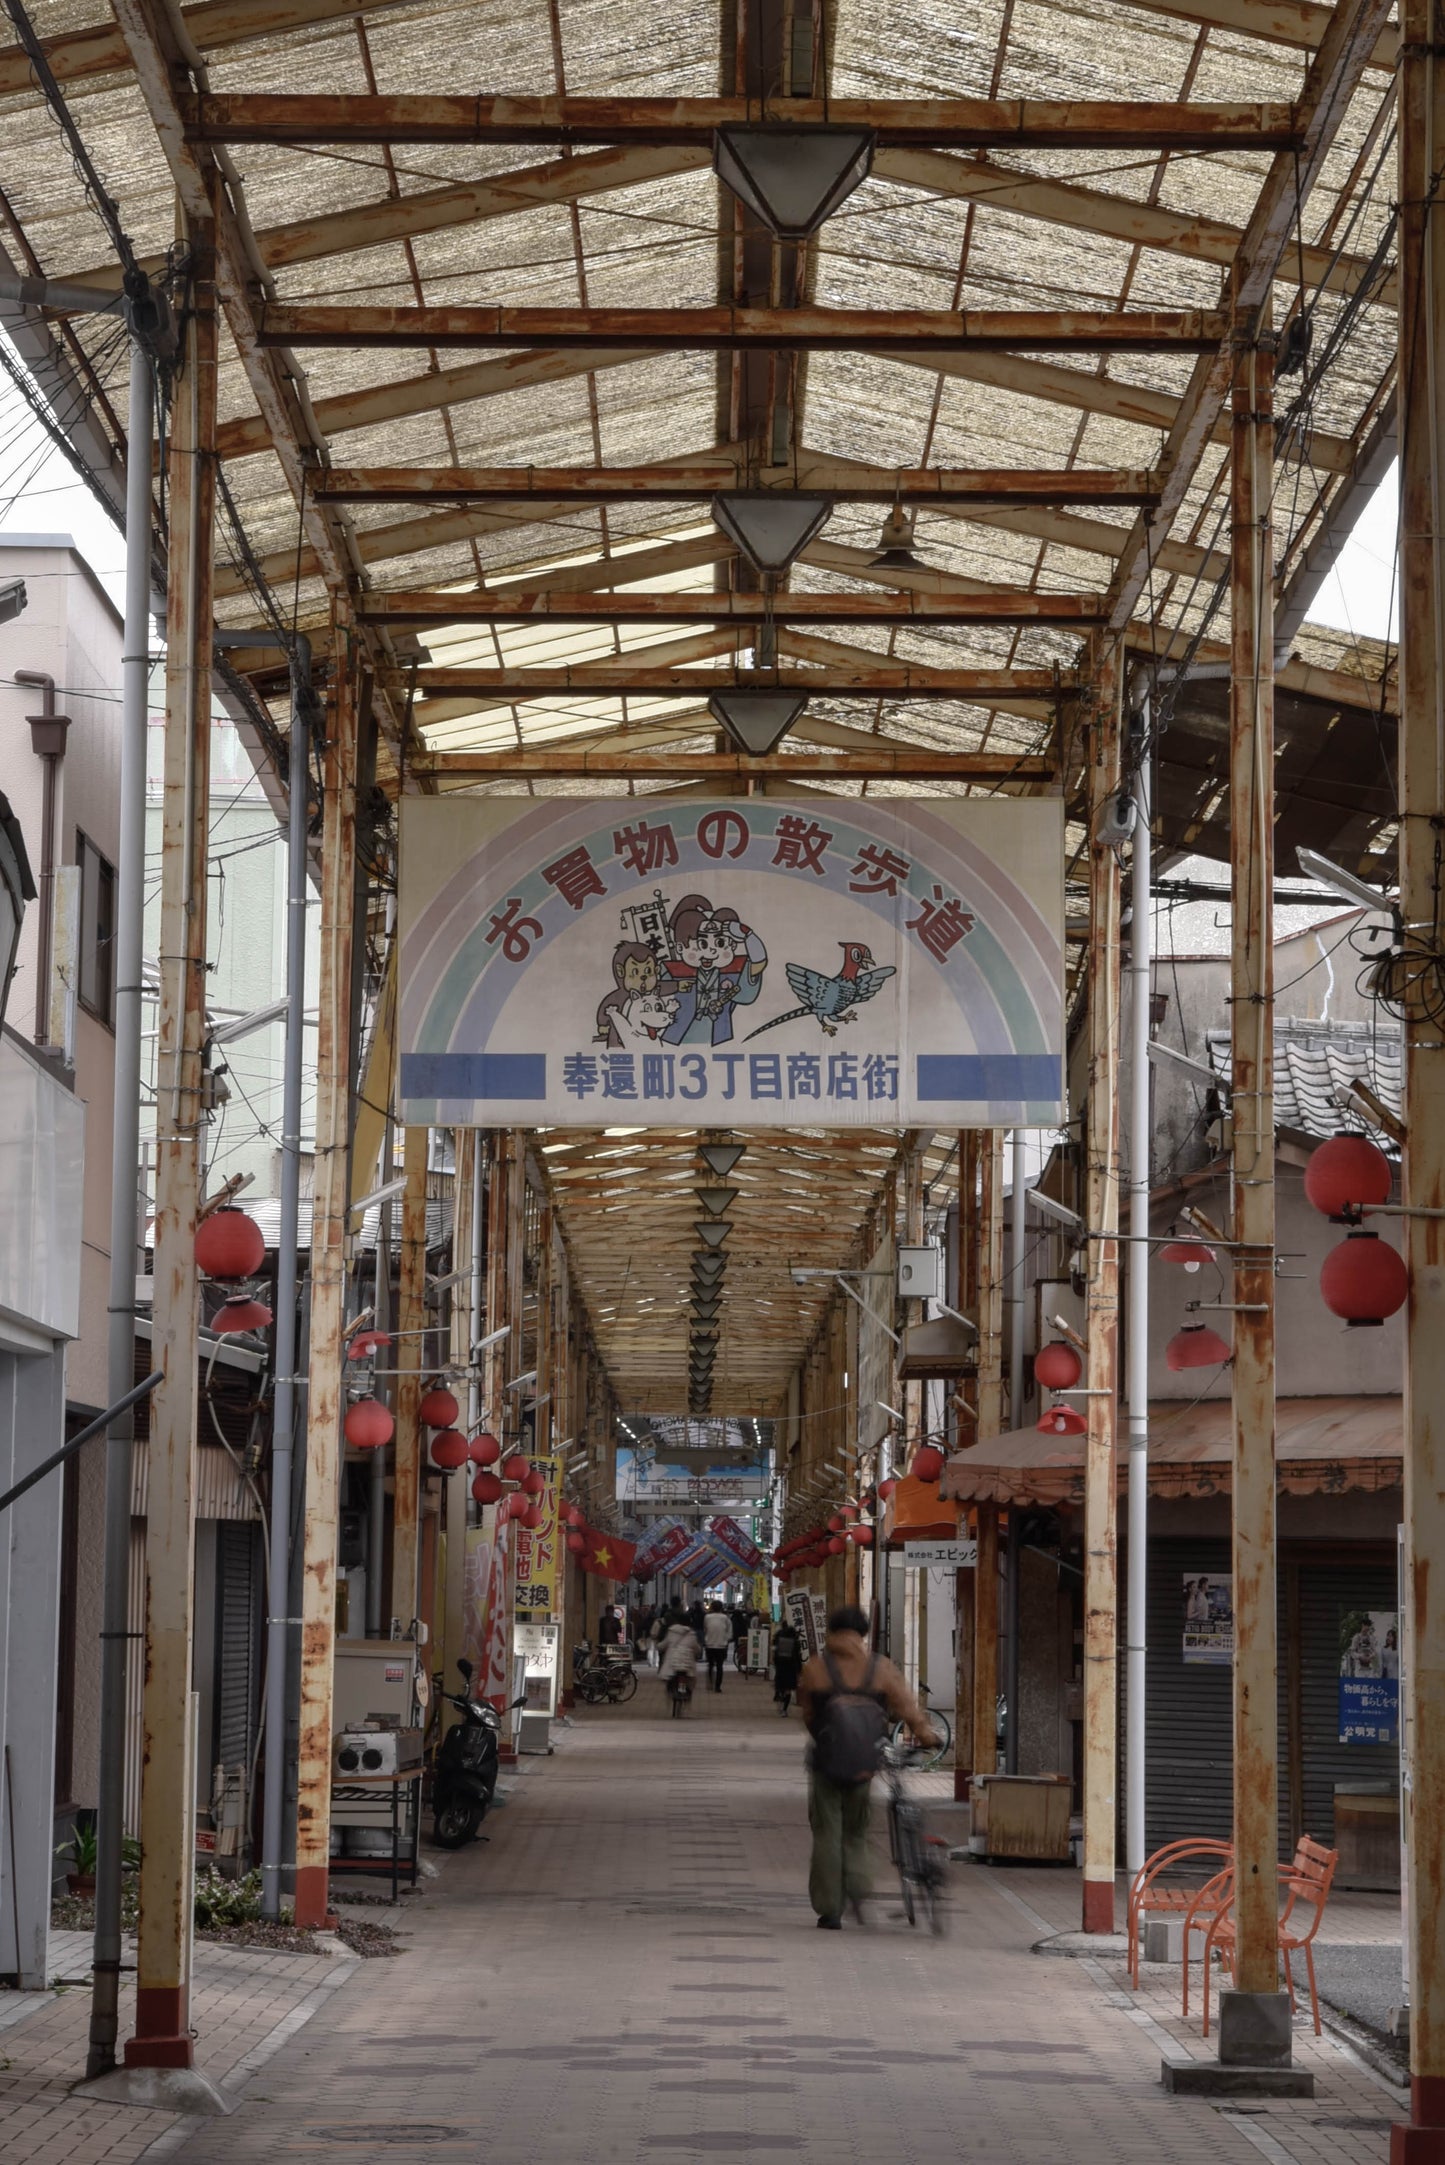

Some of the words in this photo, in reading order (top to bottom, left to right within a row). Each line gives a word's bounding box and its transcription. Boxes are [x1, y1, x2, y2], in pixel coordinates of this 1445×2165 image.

[484, 810, 980, 963] お買物の散歩道
[562, 1051, 900, 1101] 奉還町3丁目商店街
[529, 1461, 558, 1482] 計
[516, 1584, 550, 1607] 交換
[1344, 1726, 1377, 1737] 公明党
